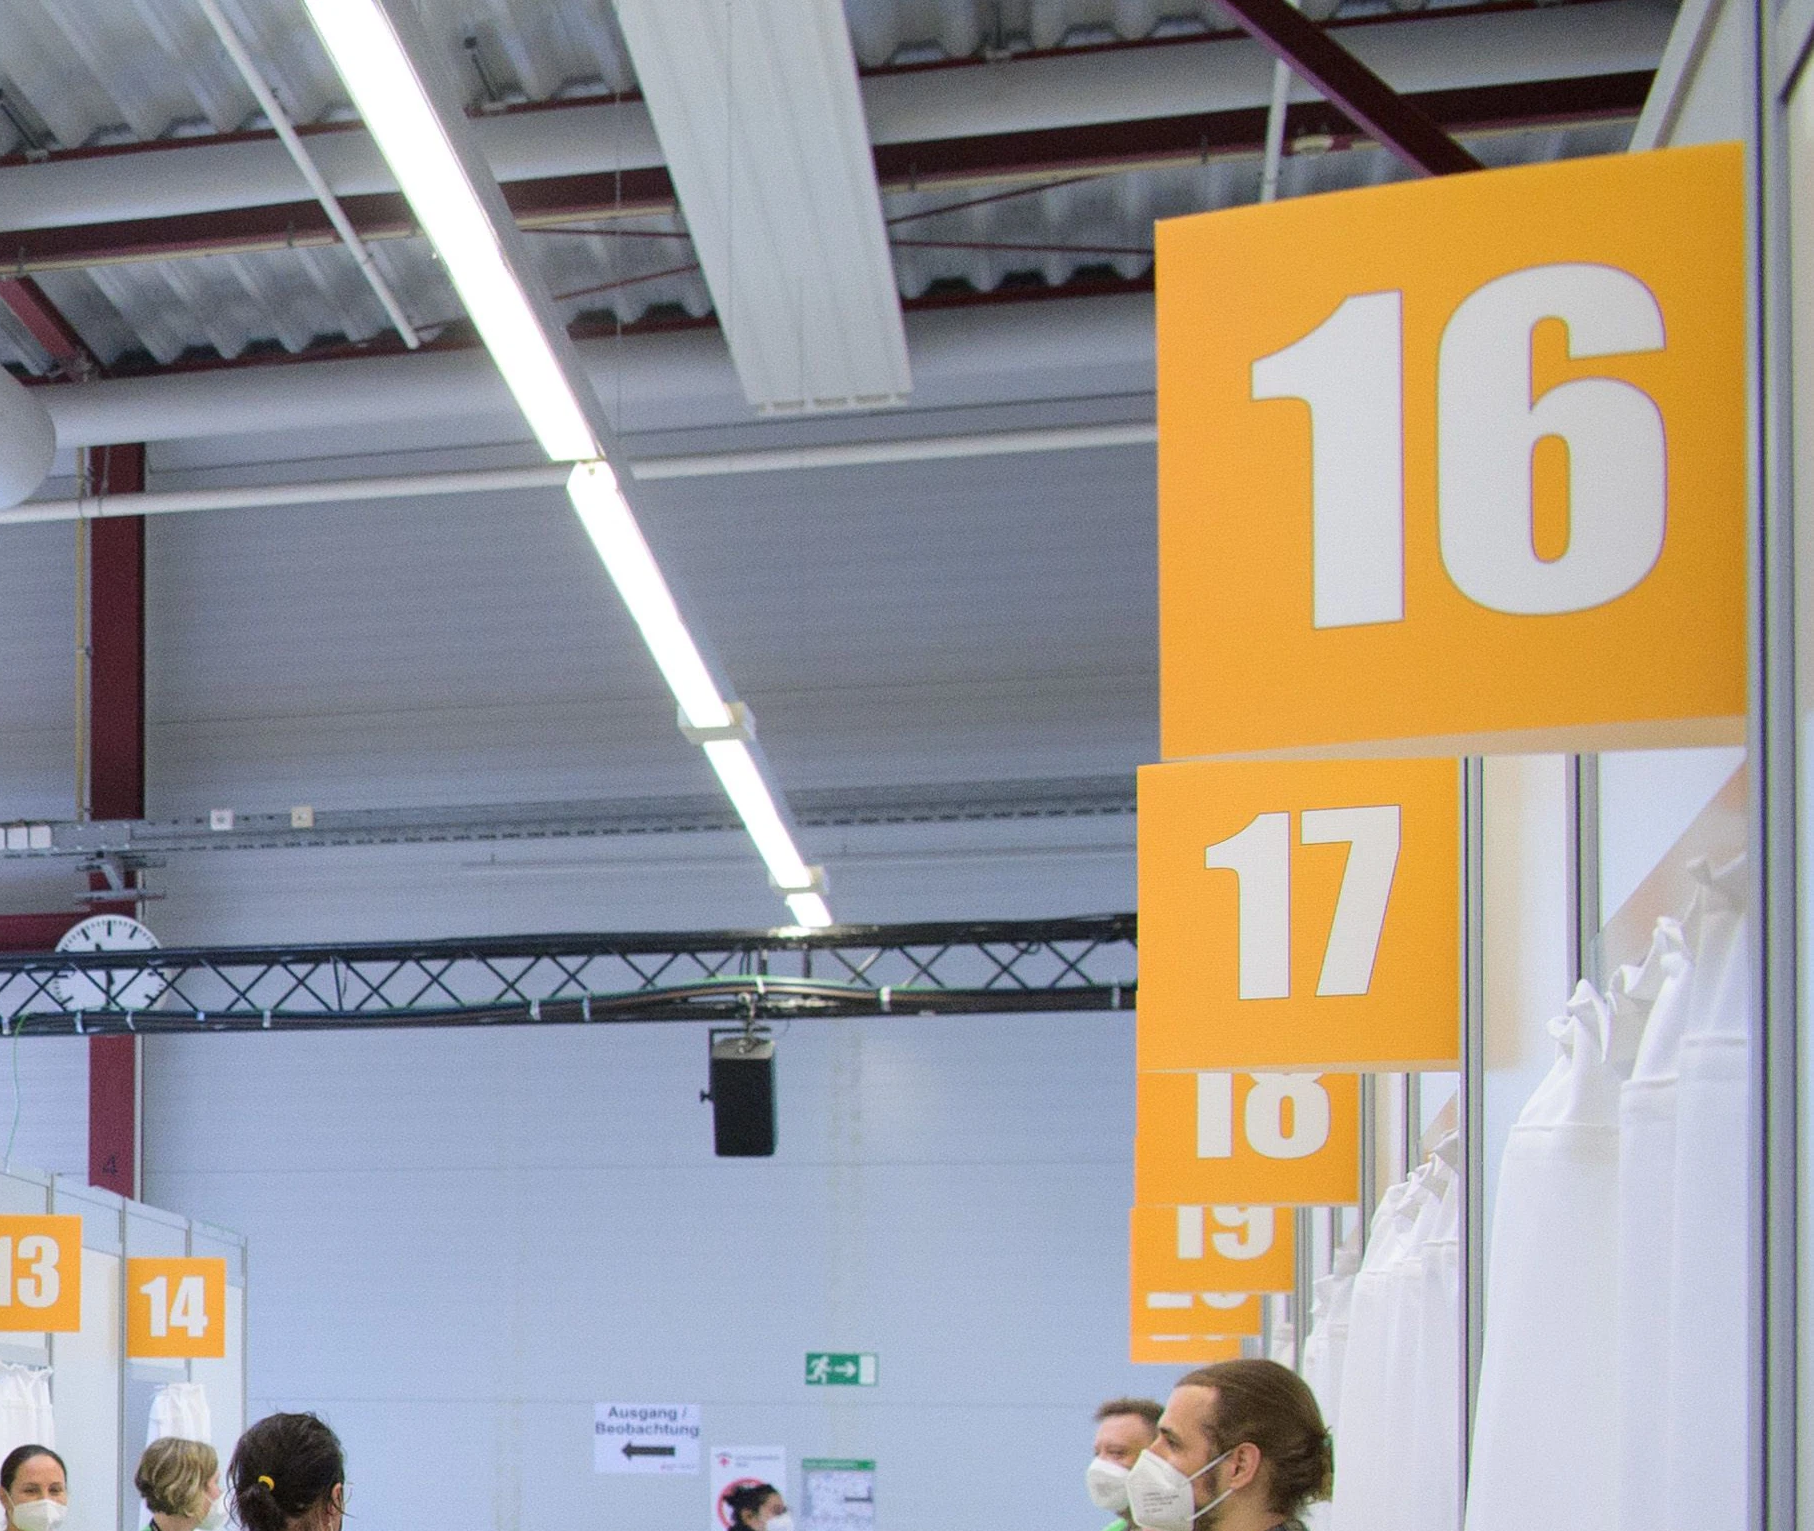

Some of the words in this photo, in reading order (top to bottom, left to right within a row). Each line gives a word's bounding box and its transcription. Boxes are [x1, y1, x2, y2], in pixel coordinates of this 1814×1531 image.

[1251, 260, 1669, 630] 16
[1204, 804, 1403, 1001] 17
[1196, 1073, 1332, 1160] 18
[139, 1274, 210, 1339] 14
[594, 1422, 701, 1438] Beobachtung
[608, 1406, 678, 1421] Ausgang
